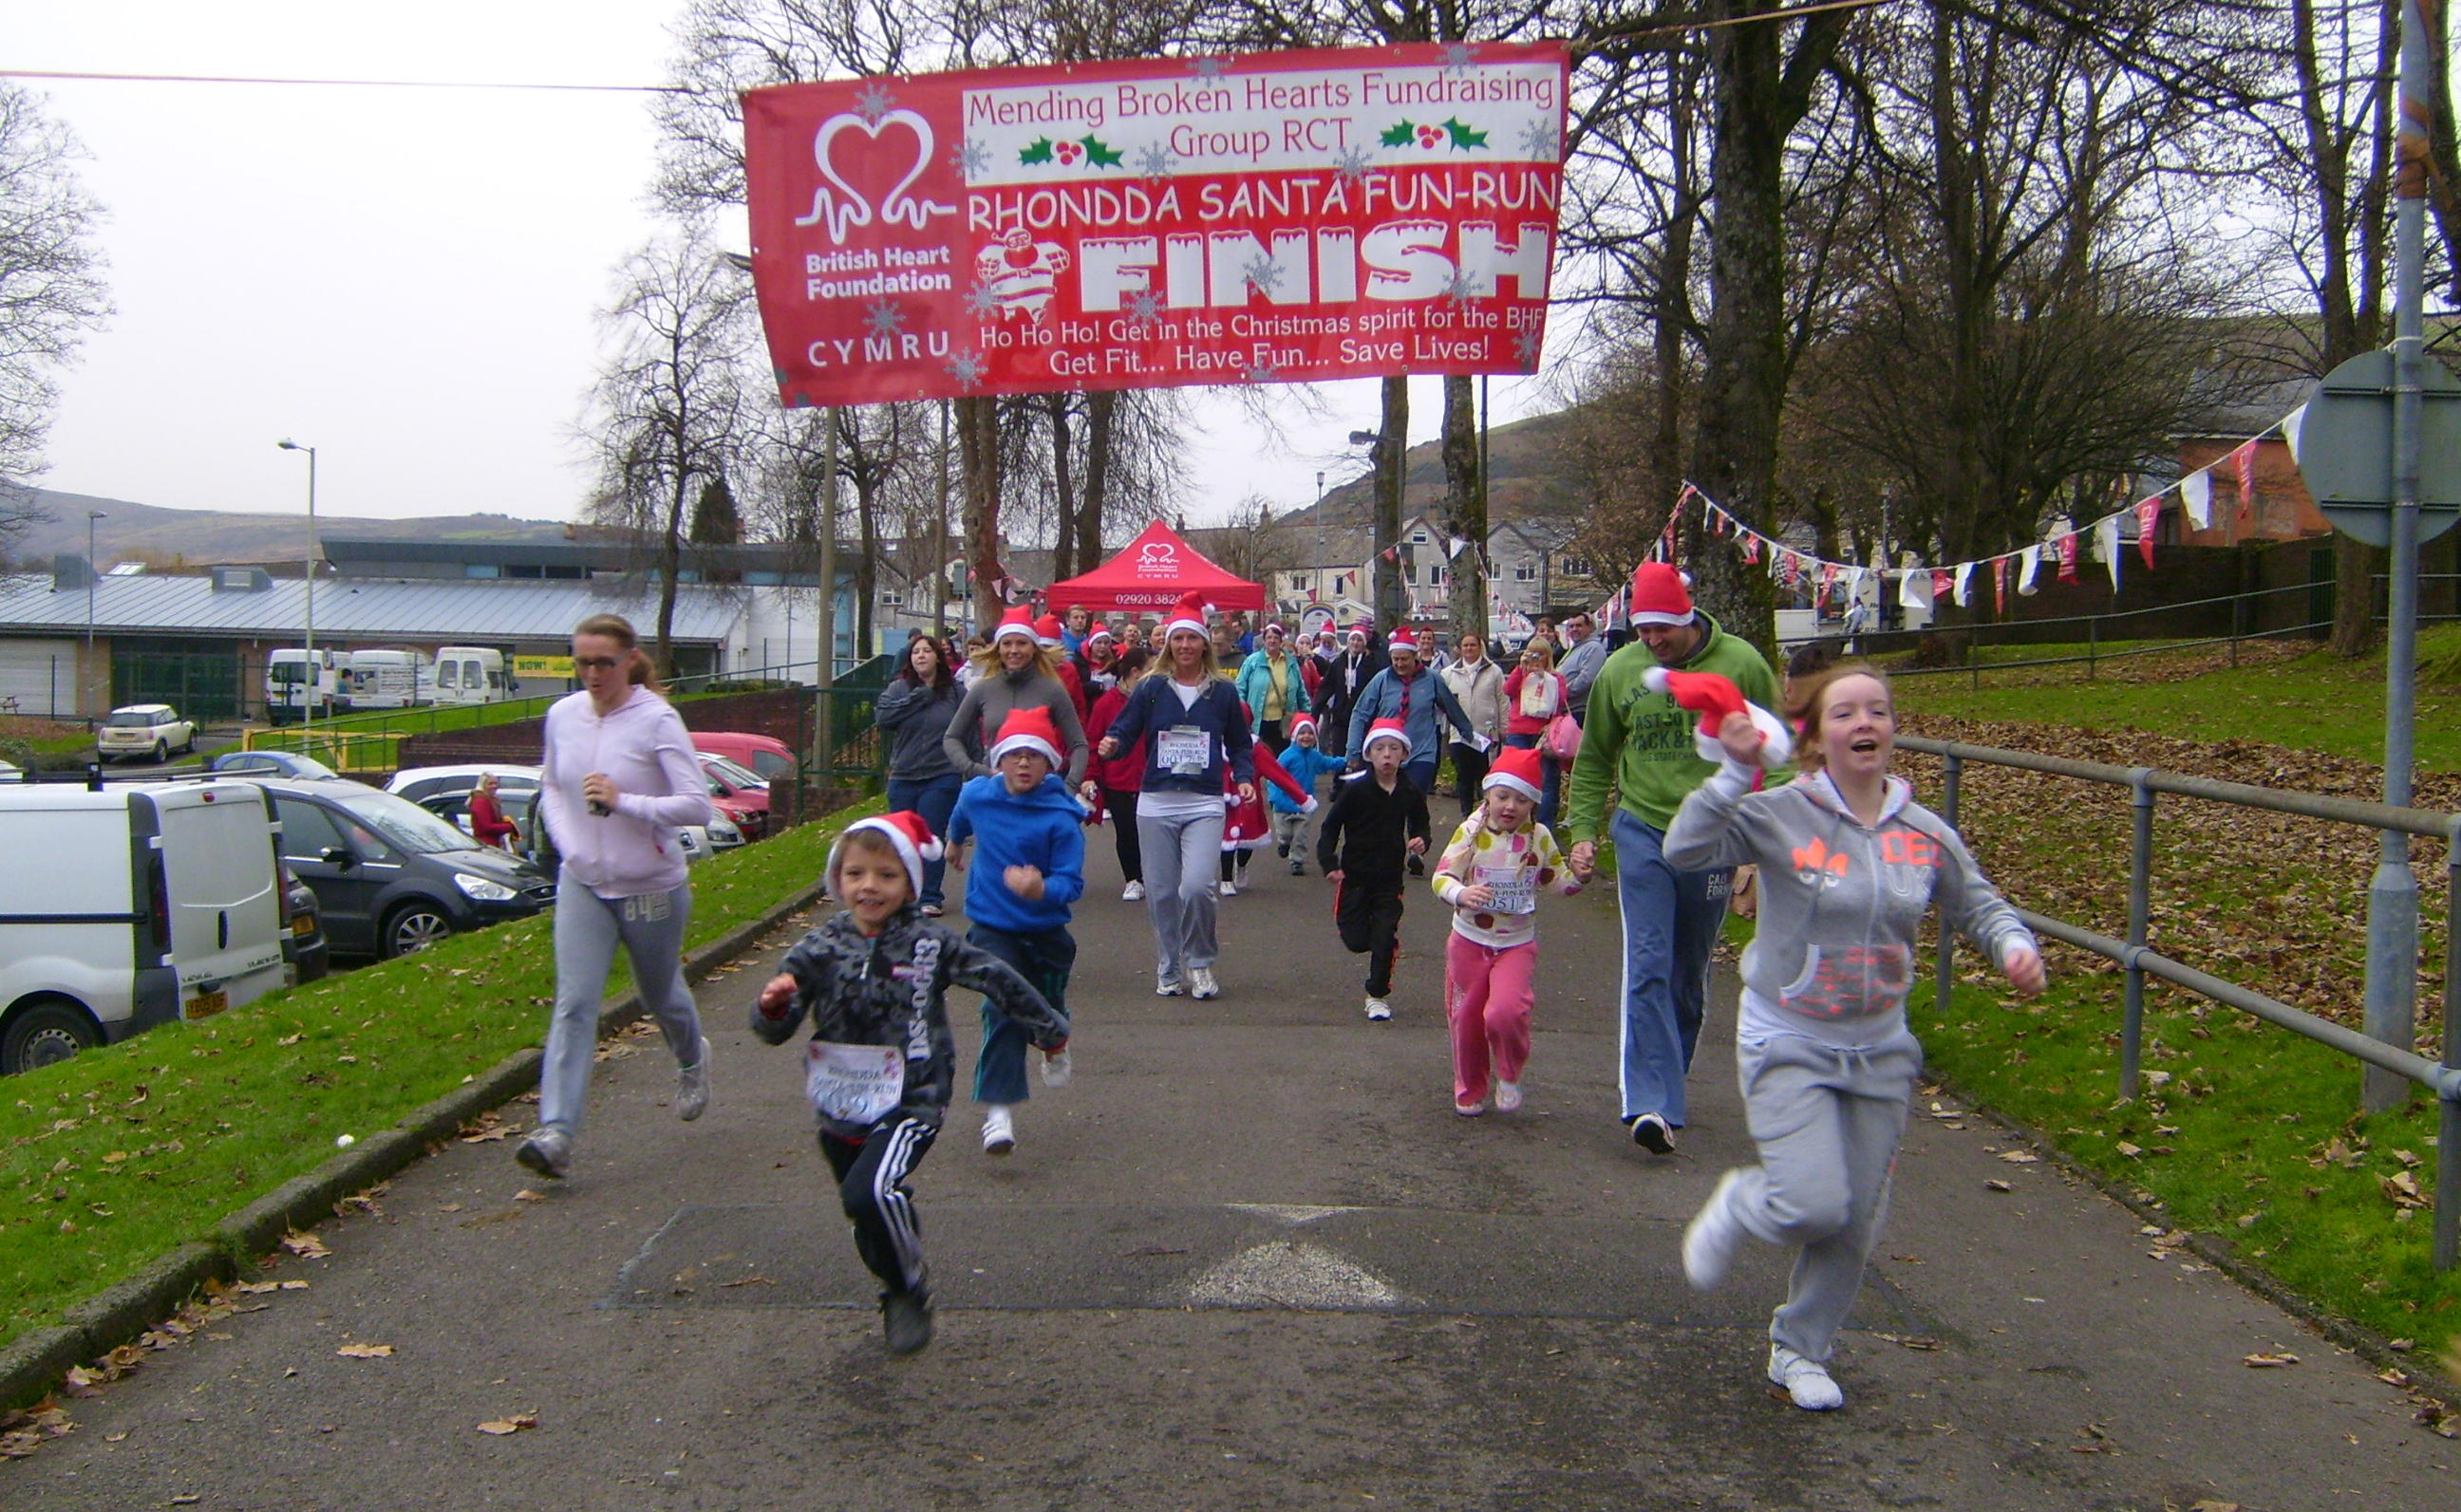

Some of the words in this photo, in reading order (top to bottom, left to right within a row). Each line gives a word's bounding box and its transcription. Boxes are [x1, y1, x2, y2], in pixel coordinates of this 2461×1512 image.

[969, 89, 1105, 128] Mending
[1117, 82, 1231, 118] Broken
[1245, 78, 1350, 111] Hearts
[1362, 70, 1554, 109] Fundraising
[1170, 124, 1270, 163] Group
[1283, 118, 1352, 152] RCT
[967, 184, 1181, 232] RHONDDA
[1198, 177, 1348, 221] SANTA
[1364, 172, 1557, 215] FUN-RUN
[806, 249, 879, 274] British
[884, 245, 950, 268] Heart
[1080, 219, 1550, 312] FINISH
[807, 271, 950, 301] Foundation
[980, 326, 1013, 349] Ho
[1021, 323, 1053, 345] Ho
[1061, 320, 1100, 343] Ho!
[1108, 319, 1151, 341] Get
[1158, 318, 1178, 339] in
[1186, 316, 1223, 338] the
[1230, 314, 1350, 337] Christmas
[1359, 308, 1415, 337] spirit
[1424, 305, 1456, 327] for
[1463, 308, 1498, 328] the
[1506, 307, 1544, 330] BHF
[809, 331, 949, 368] CYMRU
[1049, 350, 1097, 376] Get
[1105, 346, 1165, 373] Fit...
[1174, 344, 1243, 370] Have
[1252, 342, 1329, 366] Fun...
[1340, 338, 1405, 364] Save
[1414, 334, 1489, 360] Lives!
[1116, 594, 1152, 605] 02920
[1886, 864, 1932, 897] UK
